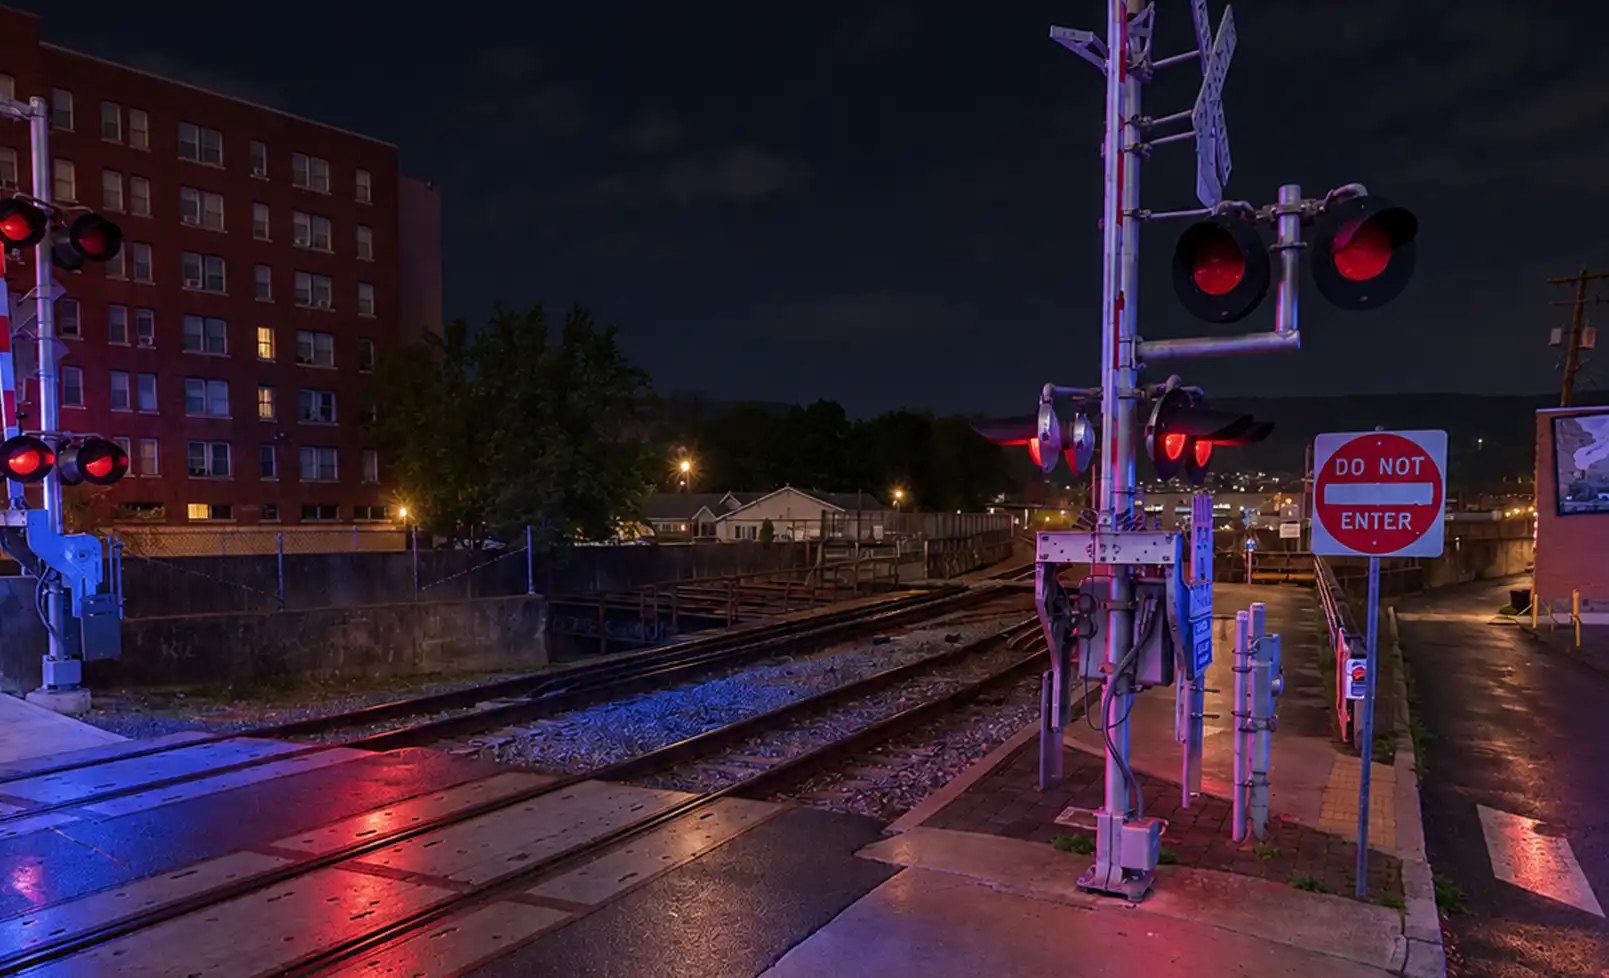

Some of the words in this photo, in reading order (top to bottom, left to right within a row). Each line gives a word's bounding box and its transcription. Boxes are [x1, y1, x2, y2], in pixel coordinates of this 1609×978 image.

[1335, 458, 1365, 476] DO
[1379, 456, 1425, 476] NOT
[1341, 511, 1412, 530] ENTER
